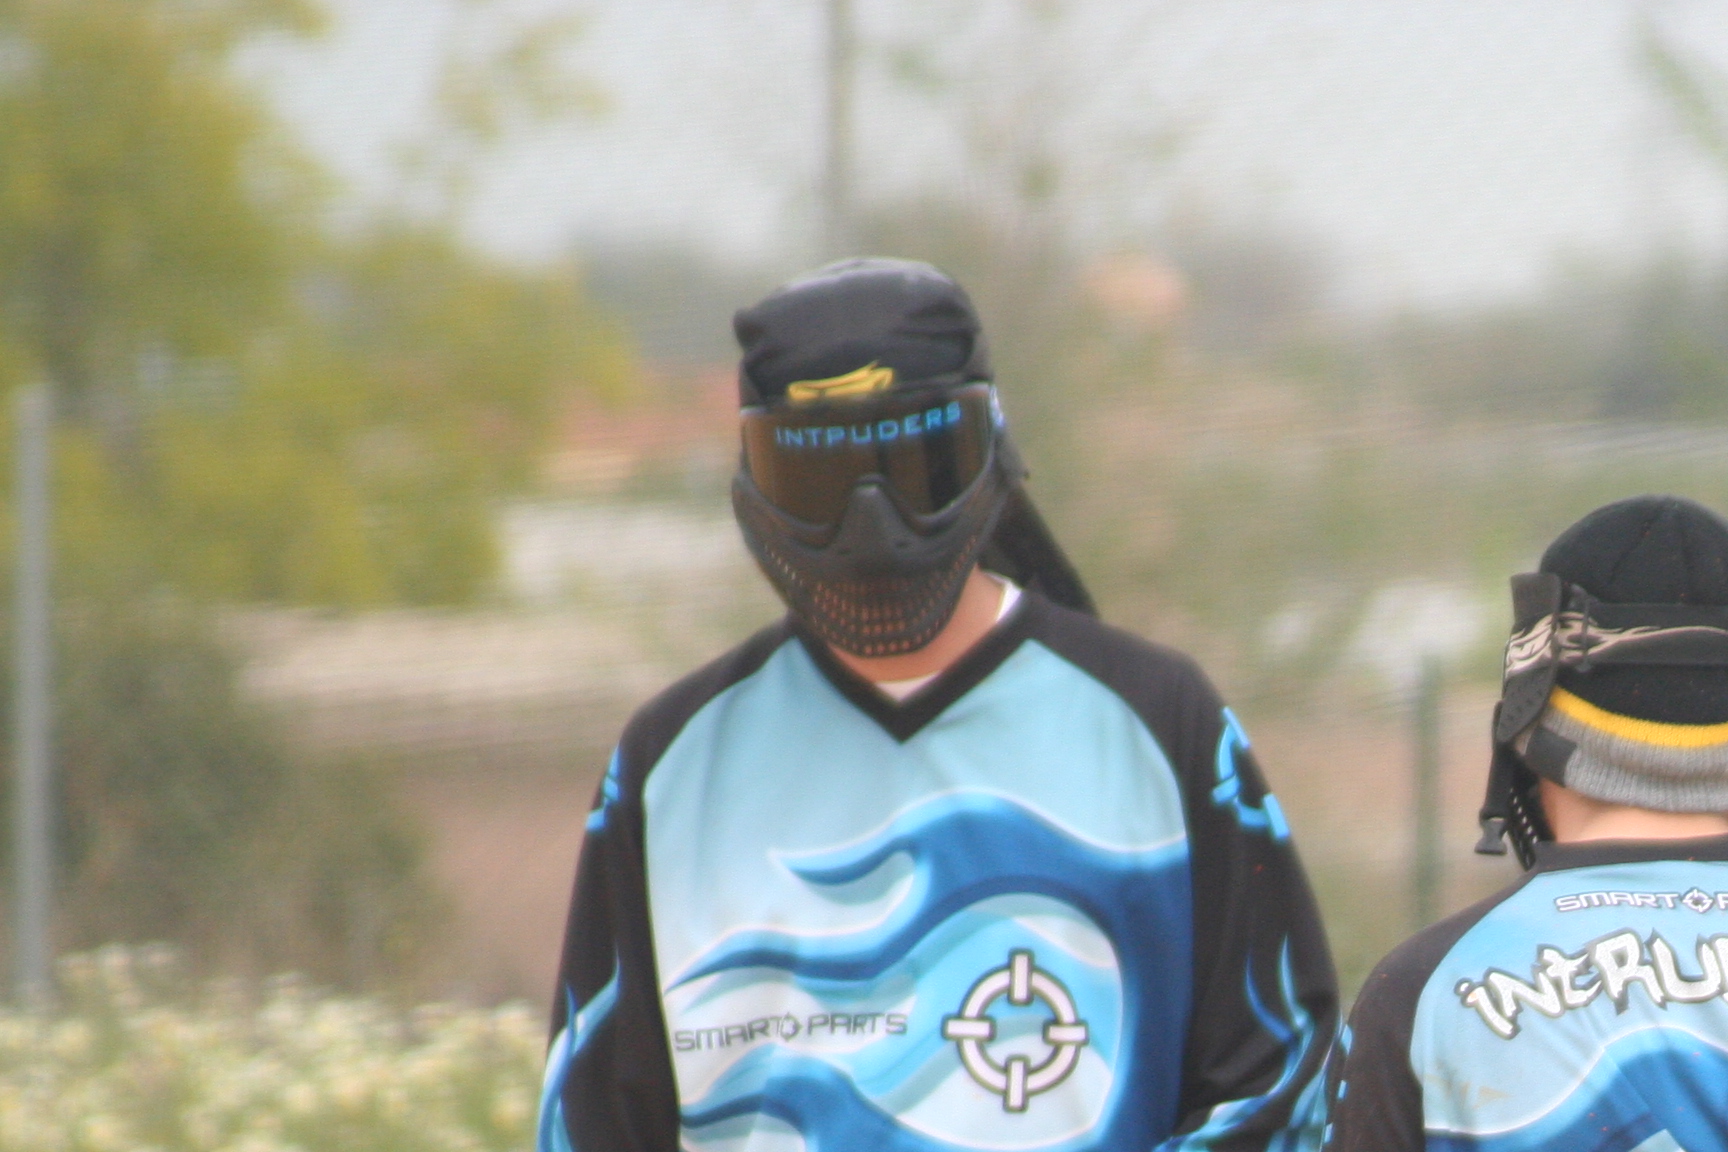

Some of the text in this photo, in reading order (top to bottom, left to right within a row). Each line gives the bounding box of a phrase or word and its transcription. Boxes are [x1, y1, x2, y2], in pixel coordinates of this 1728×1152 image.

[1555, 891, 1680, 912] SMART
[674, 1012, 908, 1051] SMART PARTS
